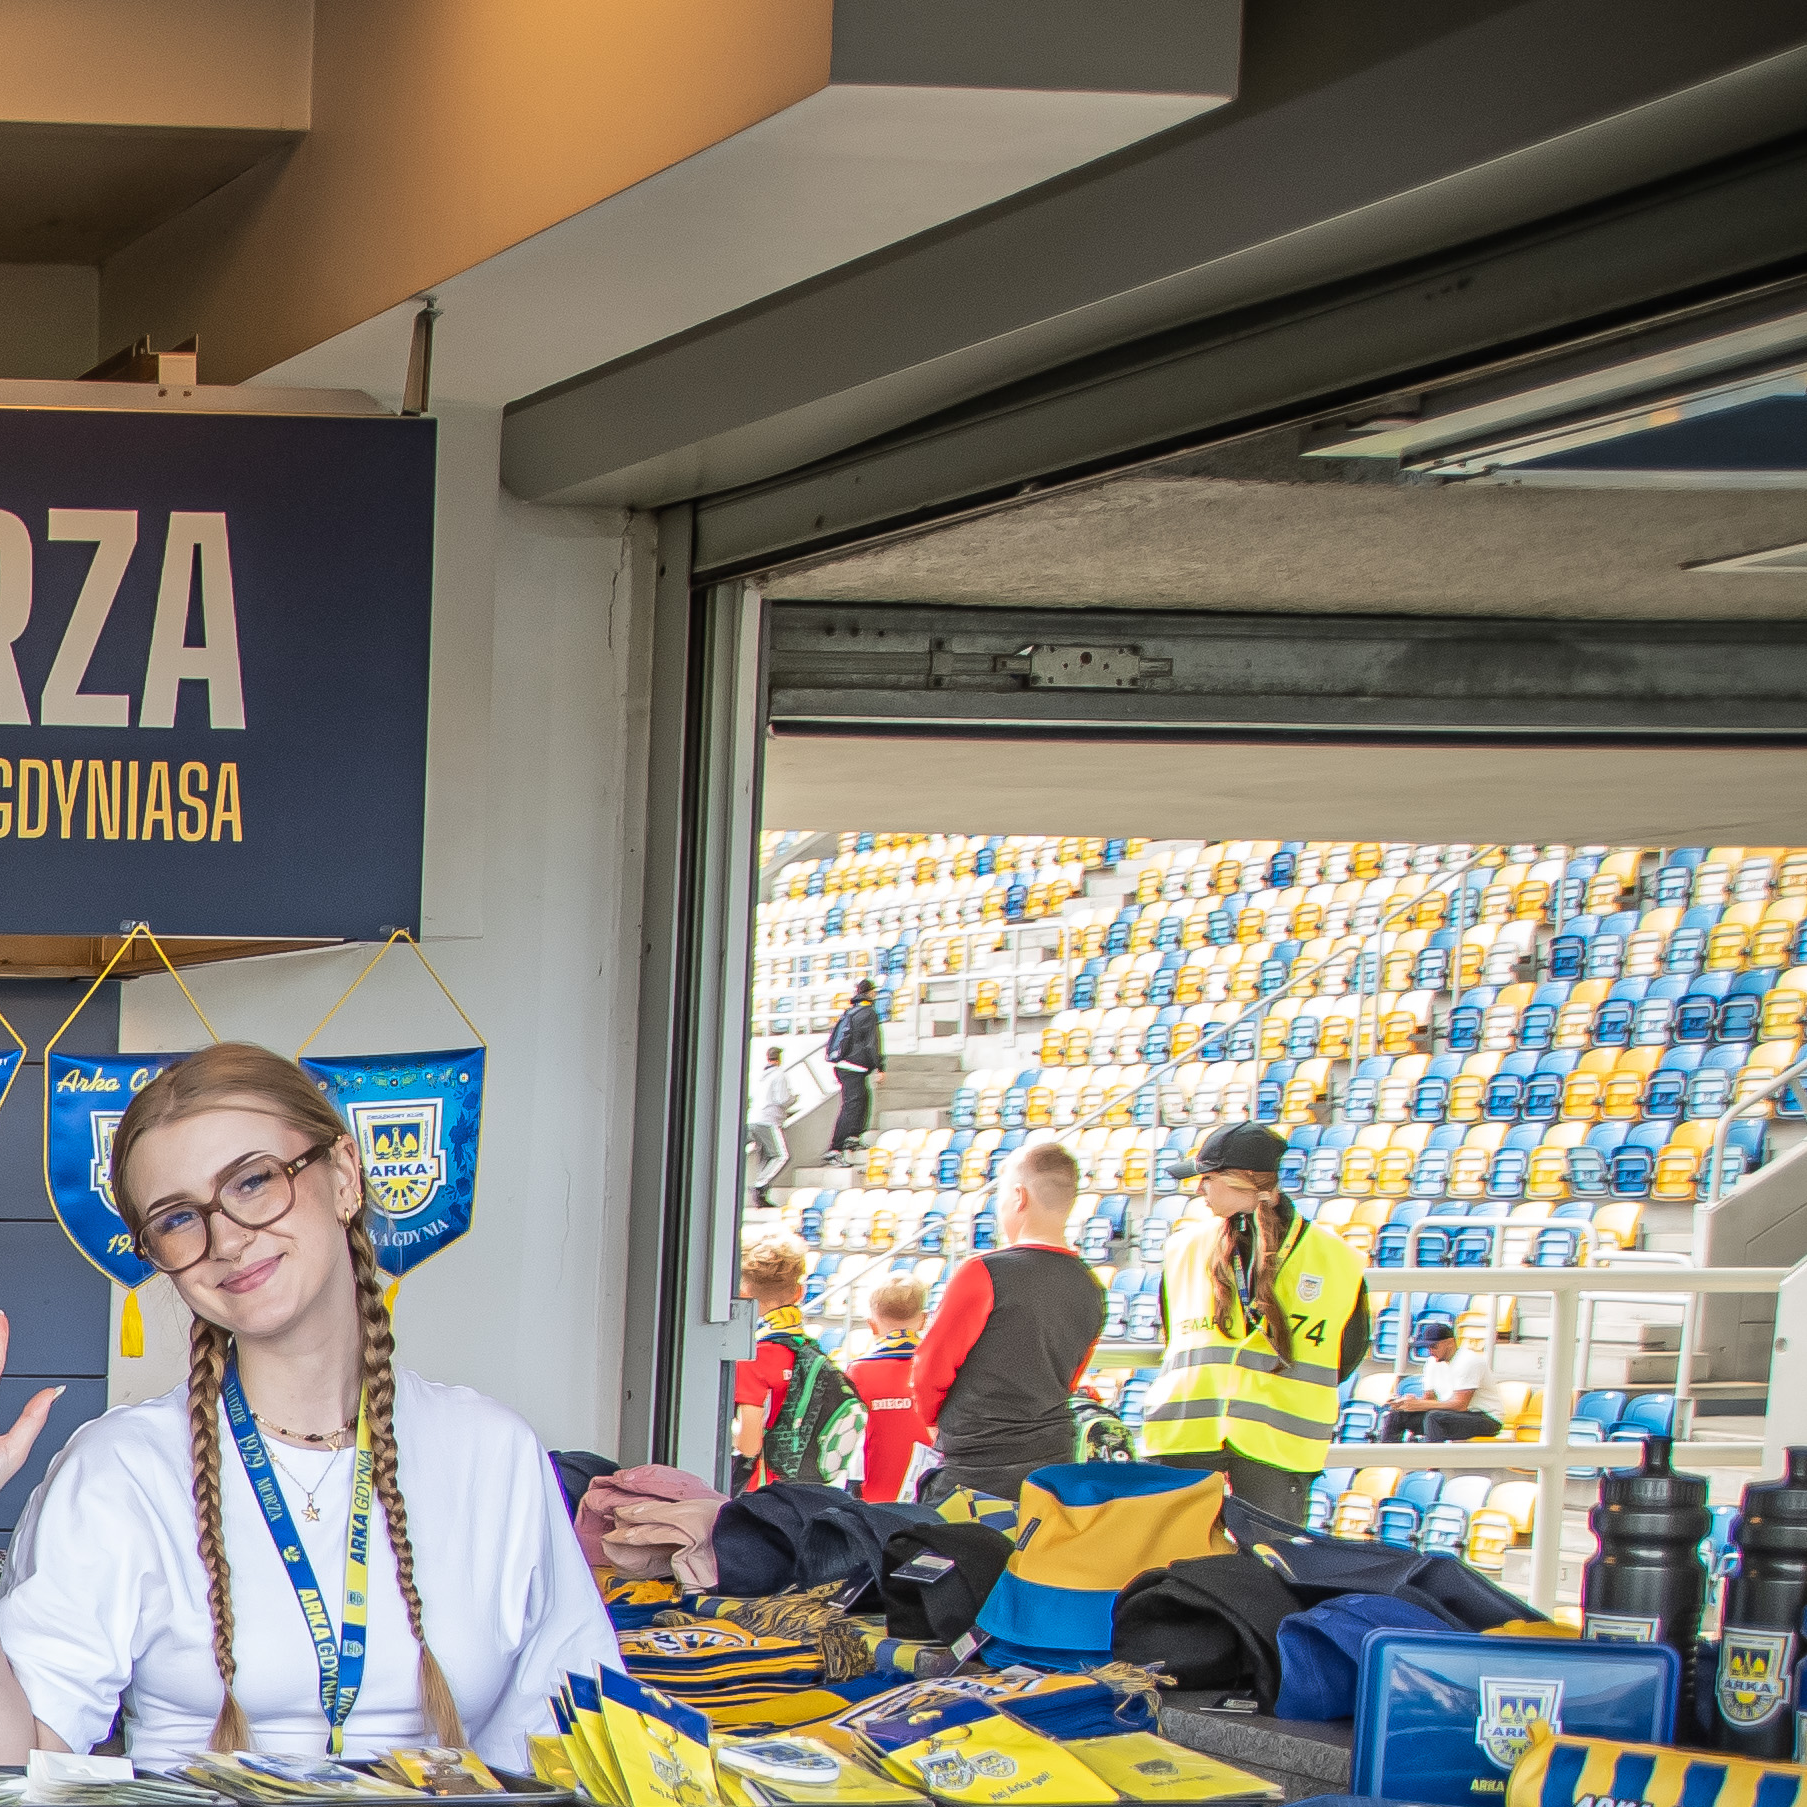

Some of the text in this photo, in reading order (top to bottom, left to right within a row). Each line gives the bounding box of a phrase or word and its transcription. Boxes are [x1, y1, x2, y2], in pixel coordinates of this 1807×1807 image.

[369, 1164, 427, 1179] ARKA
[393, 1221, 451, 1247] GDYNIA
[237, 1432, 267, 1469] 1929
[255, 1477, 284, 1523] MORZA
[350, 1449, 374, 1566] GDYNIA ARKA
[298, 1589, 339, 1709] ARKA GDYNIA
[1724, 1679, 1772, 1692] ARKA
[1471, 1778, 1505, 1793] ARKA
